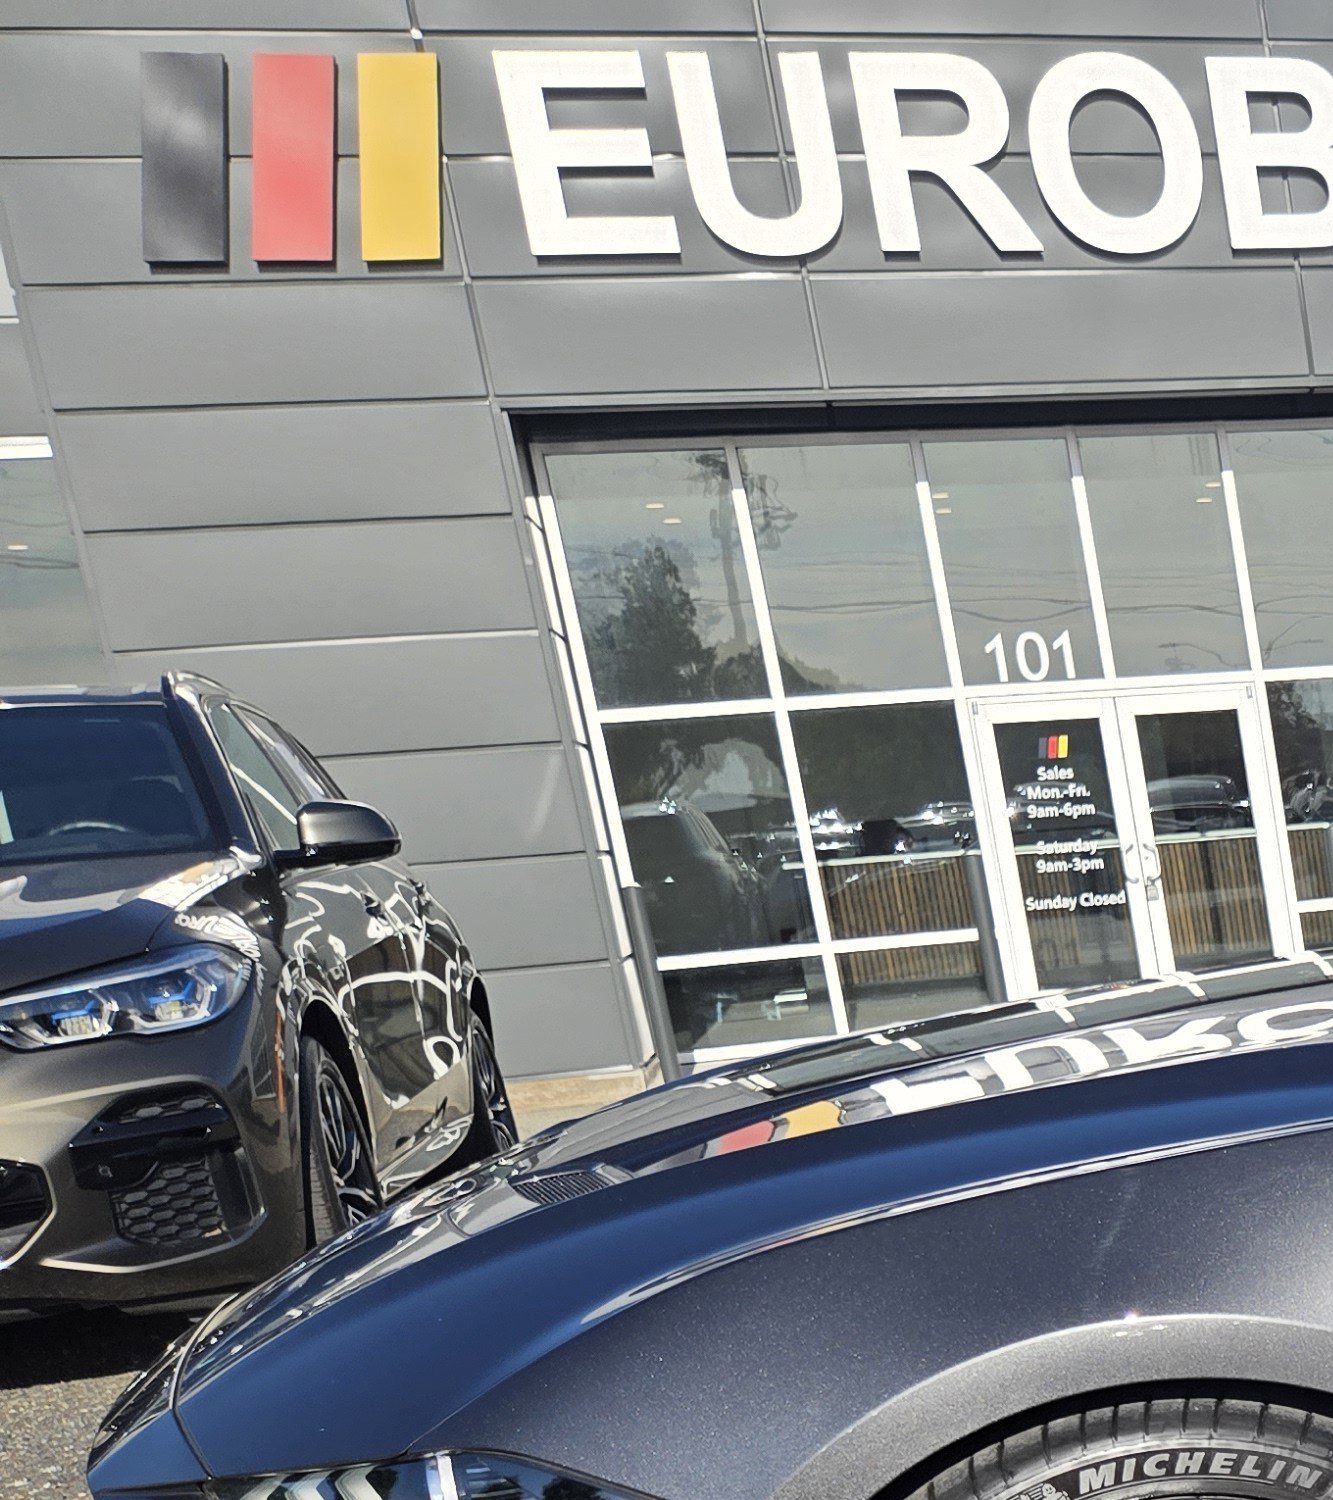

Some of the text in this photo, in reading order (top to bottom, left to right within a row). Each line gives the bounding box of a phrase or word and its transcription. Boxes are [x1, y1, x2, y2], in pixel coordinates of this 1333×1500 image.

[984, 630, 1077, 683] 101
[1036, 765, 1075, 781] Sales
[1026, 802, 1096, 819] 9am-6pm
[1036, 838, 1099, 855] Saturday
[1036, 857, 1105, 874] 9am-3pm
[1026, 890, 1126, 911] Sunday Closed
[1078, 1452, 1323, 1495] MICHELIN
